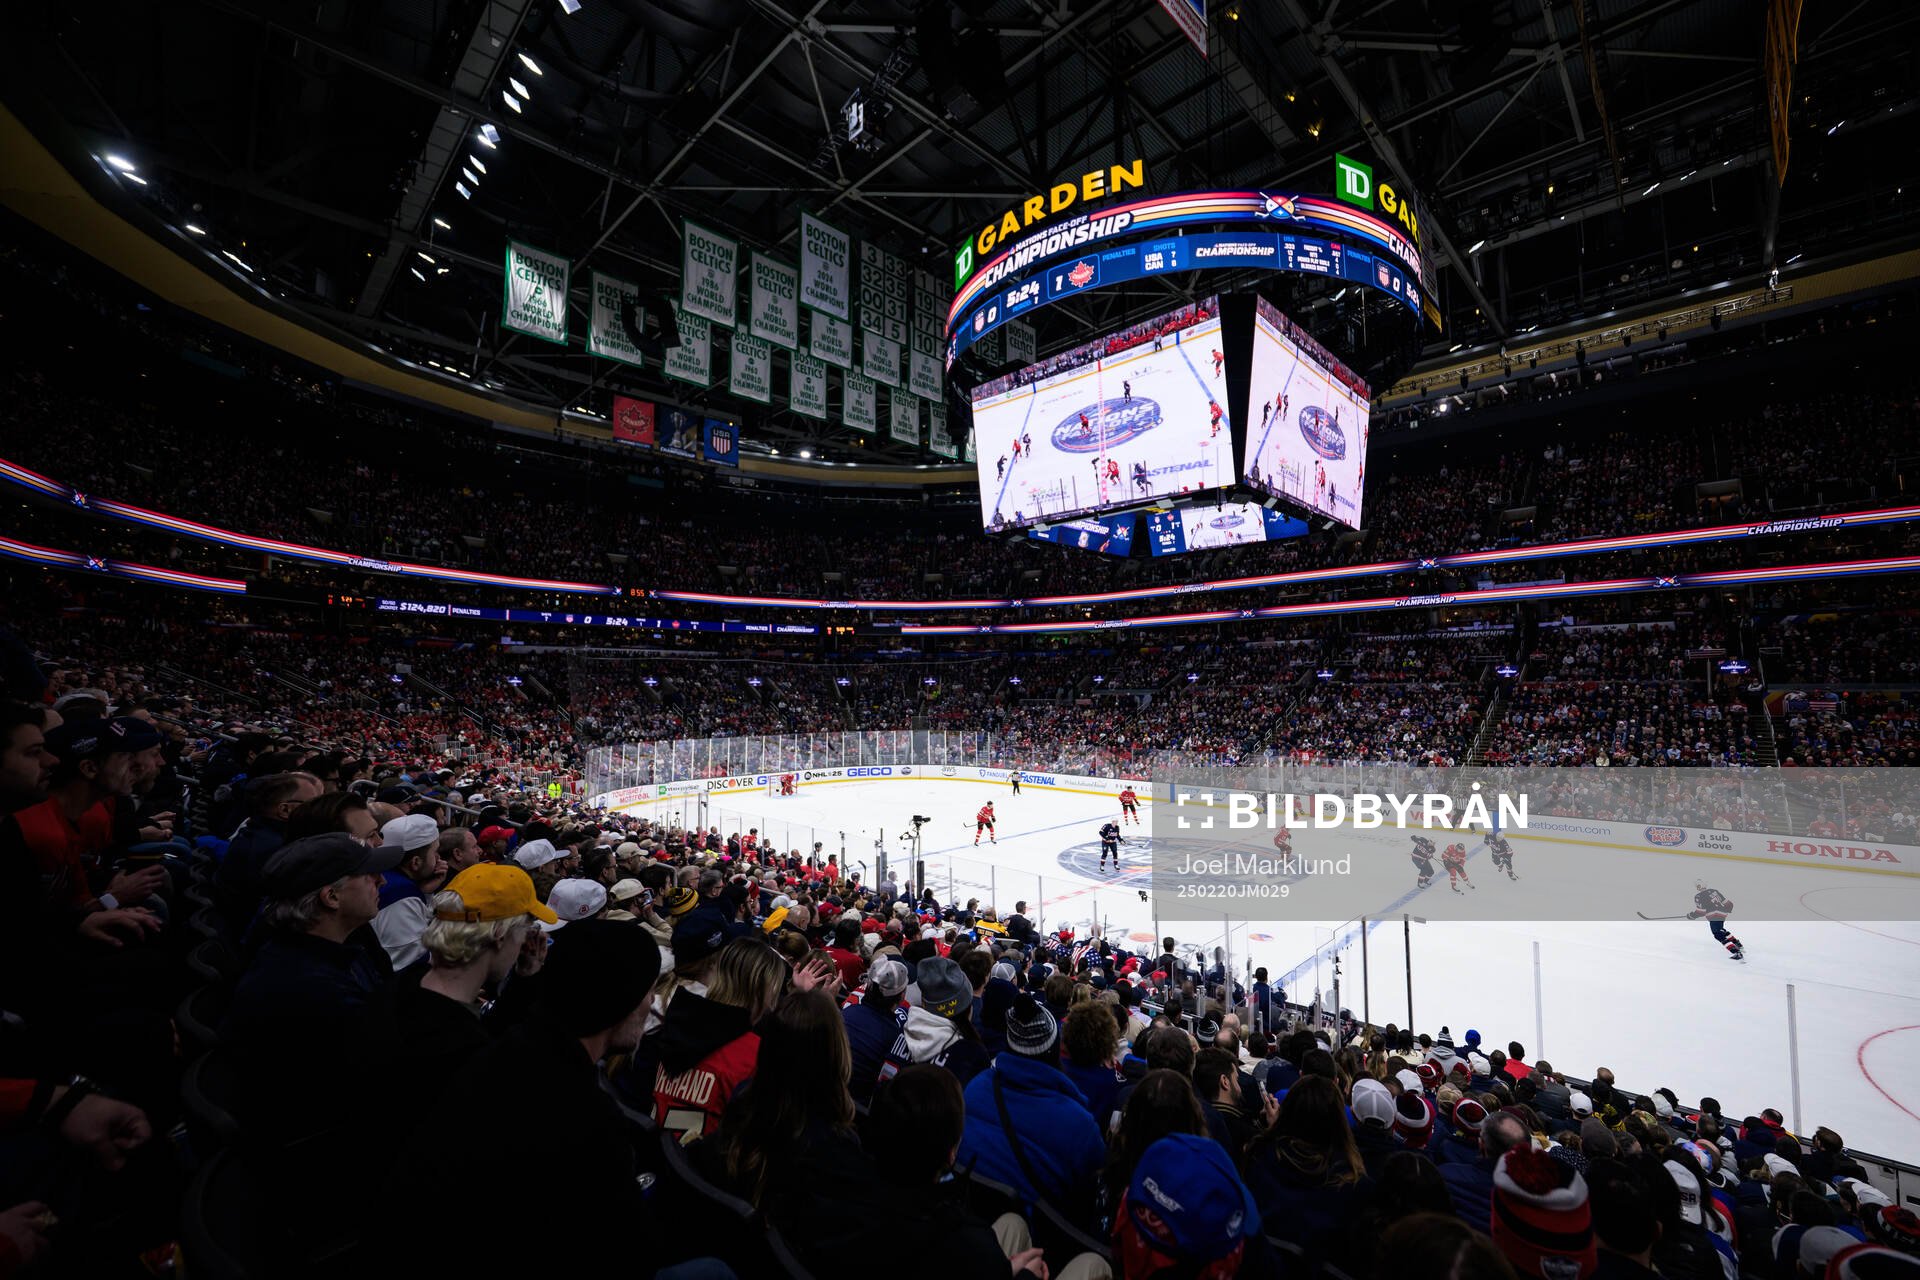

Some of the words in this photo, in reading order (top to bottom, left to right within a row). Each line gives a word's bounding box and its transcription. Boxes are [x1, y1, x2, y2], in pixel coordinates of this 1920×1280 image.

[1339, 162, 1370, 199] TD
[956, 246, 972, 279] TD
[977, 160, 1144, 255] GARDEN
[806, 223, 846, 254] BOSTON
[1015, 230, 1048, 252] NATIONS
[1048, 215, 1088, 235] FACE-OFF
[689, 233, 733, 261] BOSTON
[807, 240, 844, 268] CELTICS
[985, 213, 1131, 289] CHAMPIONSHIP
[1102, 248, 1136, 261] PENALTIES
[1196, 247, 1274, 257] CHAMPIONSHIP
[516, 252, 564, 280] BOSTON
[691, 249, 731, 274] CELTICS
[868, 246, 876, 263] 3
[886, 256, 905, 277] 33
[1145, 252, 1163, 262] USA
[1145, 260, 1164, 271] CAN
[517, 267, 561, 291] CELTICS
[702, 277, 719, 291] 1986
[756, 262, 794, 288] BOSTON
[817, 270, 833, 283] 2024
[863, 265, 882, 288] 32
[886, 278, 905, 298] 35
[1055, 275, 1063, 291] 1
[757, 276, 793, 299] CELTICS
[814, 279, 838, 297] WORLD
[1393, 277, 1400, 292] 0
[696, 285, 725, 303] WORLD
[806, 286, 845, 310] CHAMPIONS
[918, 292, 932, 311] 19
[1006, 281, 1039, 308] 5:24
[522, 303, 552, 318] WORLD
[687, 292, 733, 317] CHAMPIONS
[768, 303, 783, 316] 1984
[863, 288, 882, 310] 00
[887, 300, 904, 319] 31
[511, 310, 561, 332] CHAMPIONS
[677, 311, 707, 330] OSTON
[763, 311, 788, 327] WORLD
[918, 313, 932, 331] 17
[987, 306, 997, 323] 0
[679, 327, 705, 341] ELTICS
[754, 318, 795, 340] CHAMPIONS
[862, 310, 882, 332] 34
[892, 324, 899, 340] 5
[1008, 324, 1034, 344] BOSTON
[593, 336, 639, 355] CHAMPIONS
[813, 340, 849, 360] CHAMPIONS
[821, 334, 842, 348] WORLD
[918, 334, 932, 353] 10
[1009, 337, 1033, 355] CELTICS
[677, 352, 700, 365] WORLD
[736, 342, 767, 361] CELTICS
[669, 359, 707, 377] CHAMPIONS
[795, 363, 822, 379] CELTICS
[733, 379, 768, 394] CHAMPIONS
[741, 371, 762, 384] WORLD
[800, 391, 818, 401] WORLD
[847, 380, 872, 395] CELTICS
[793, 396, 824, 411] CHAMPIONS
[1748, 518, 1843, 535] CHAMPIONSHIP
[348, 558, 402, 572] CHAMPIONSHIP
[1173, 585, 1214, 594] CHAMPIONSHIP
[400, 602, 446, 613] $124,820
[452, 607, 481, 616] PENALTIES
[1395, 596, 1455, 607] CHAMPIONSHIP
[584, 616, 592, 624] 0
[605, 617, 628, 626] 5:24
[847, 767, 892, 777] GEICO
[1019, 771, 1056, 785] FASTENAL
[707, 777, 753, 790] DISCOVER
[1528, 822, 1611, 836] eetboston.com
[1710, 834, 1730, 842] sub
[1698, 841, 1732, 851] above
[1766, 840, 1902, 864] HONDA
